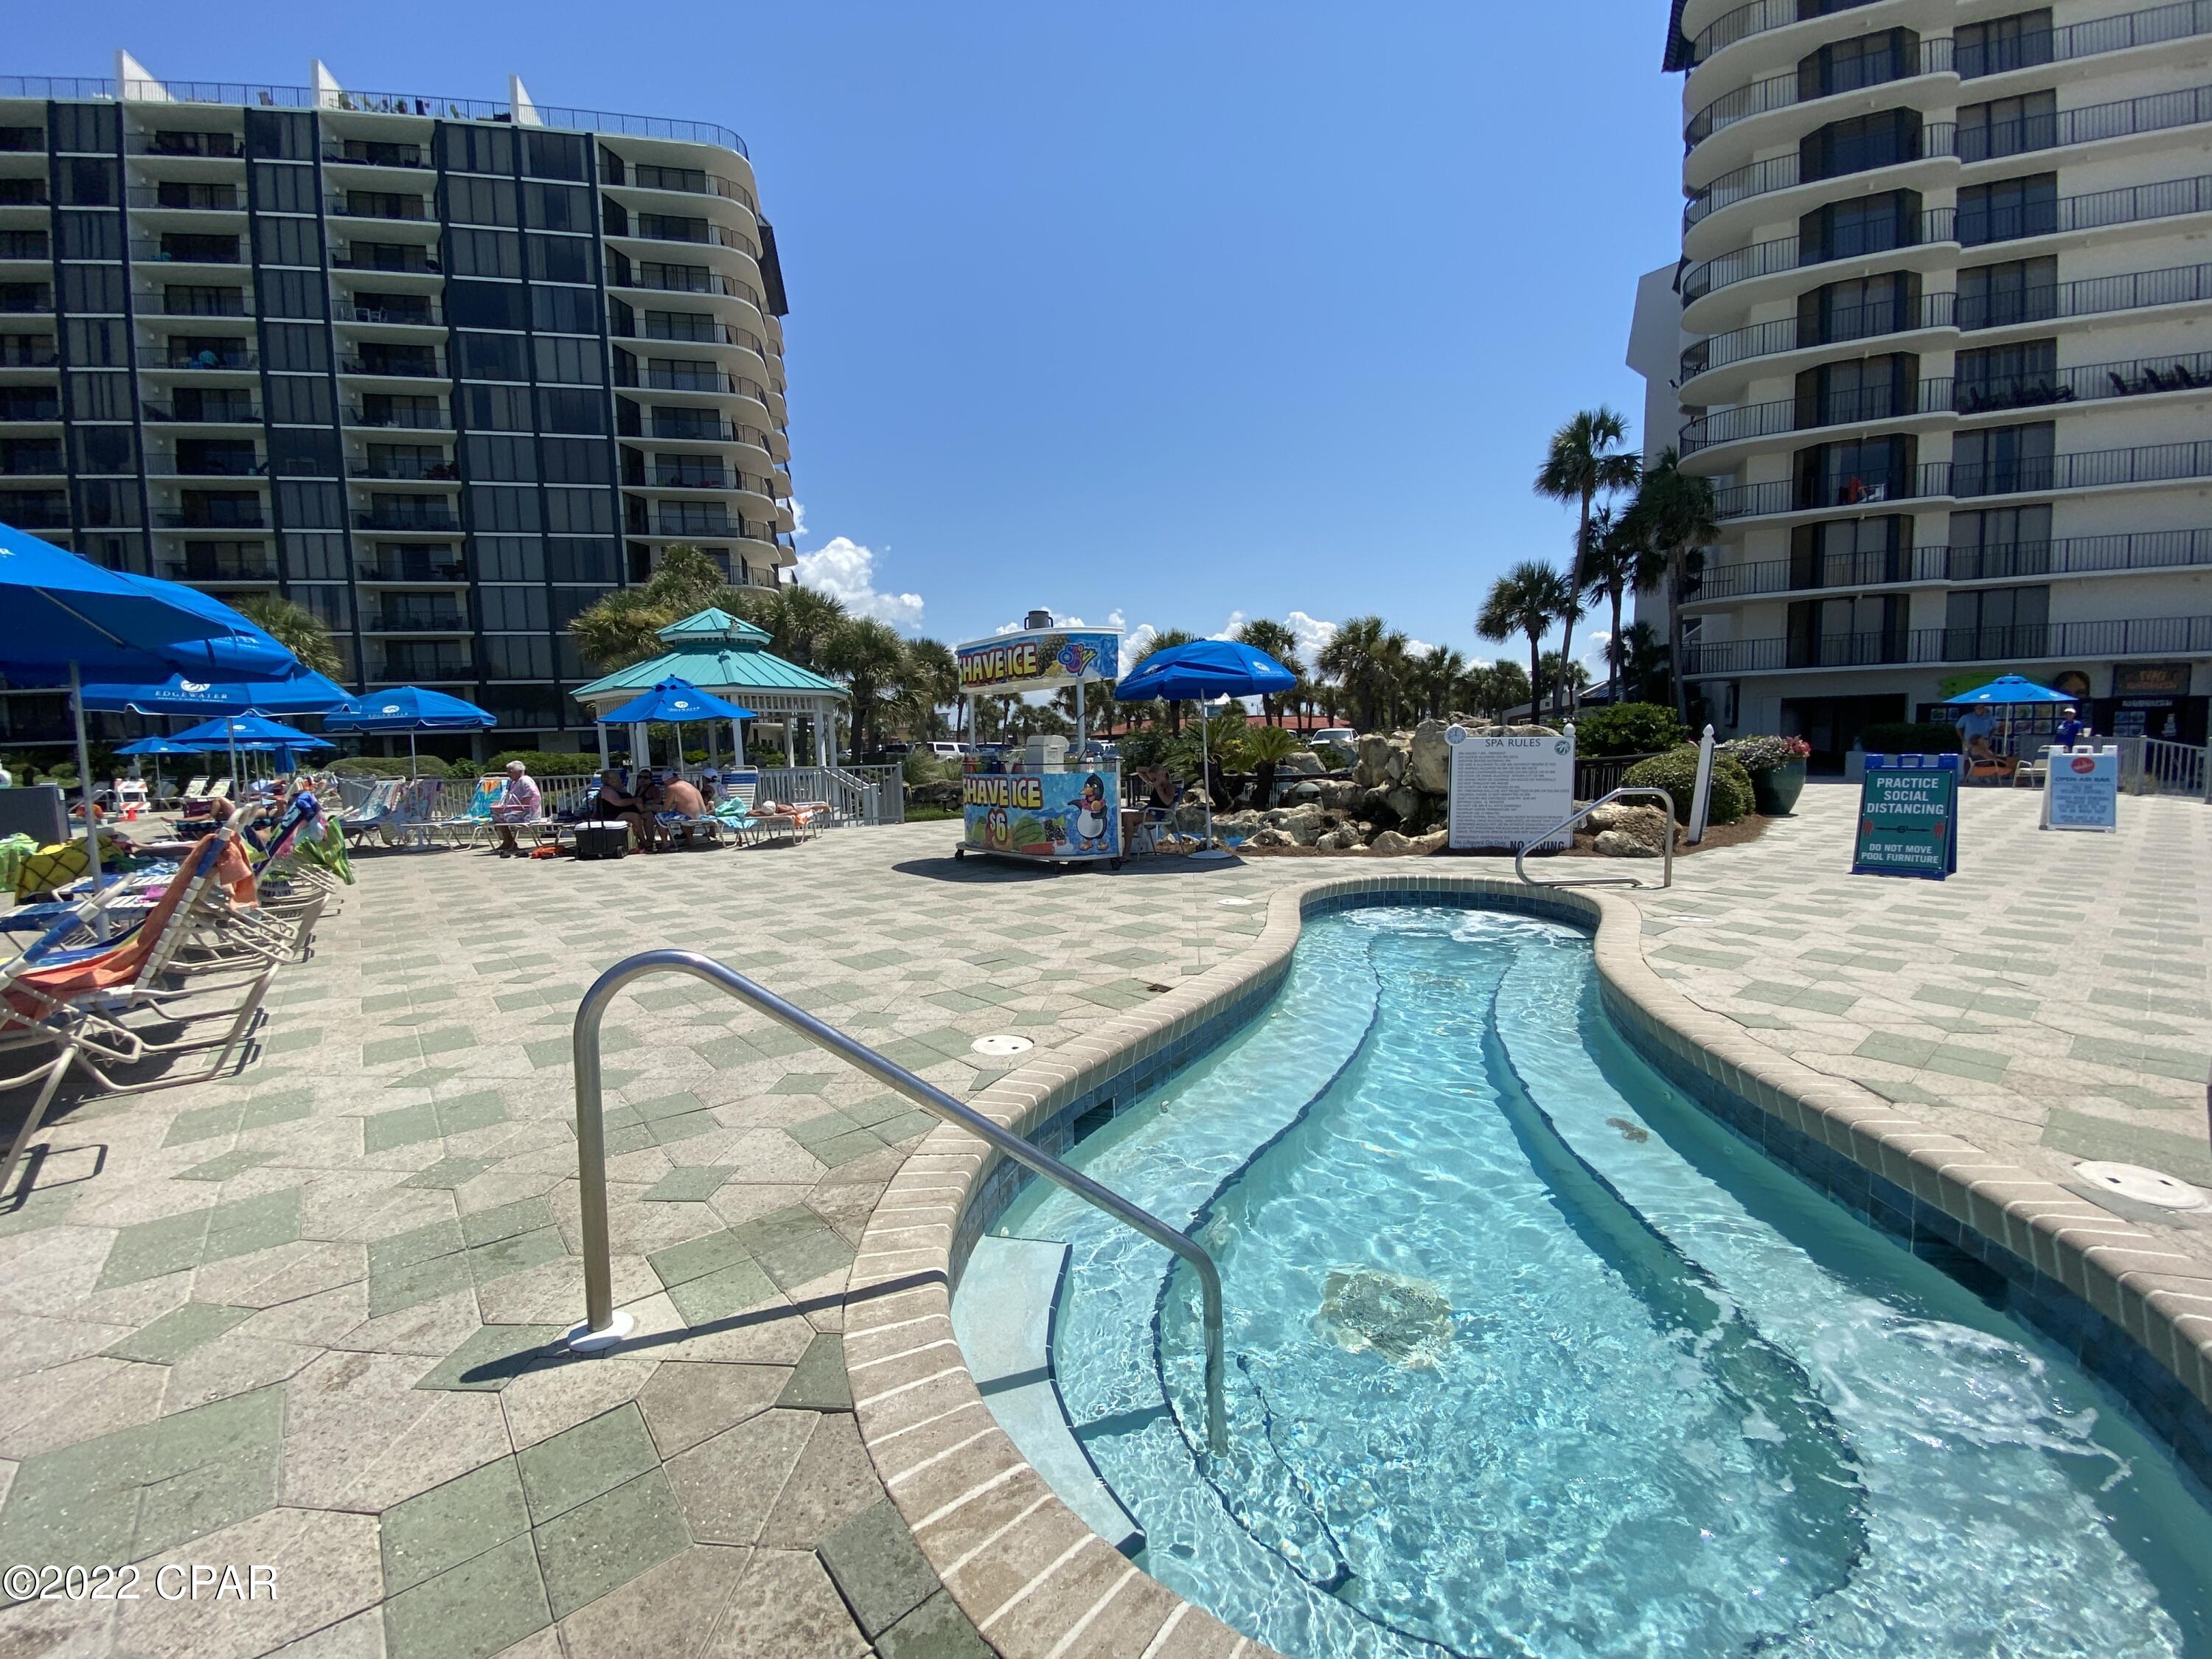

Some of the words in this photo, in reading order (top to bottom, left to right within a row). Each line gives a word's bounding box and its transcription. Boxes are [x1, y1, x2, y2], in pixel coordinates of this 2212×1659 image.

[1007, 644, 1037, 676] ICE
[155, 690, 228, 699] EDGEWATER
[1485, 739, 1504, 747] SPA
[1508, 738, 1540, 747] RULES
[1877, 778, 1939, 788] PRACTICE
[1012, 779, 1042, 808] ICE
[1883, 790, 1930, 801] SOCIAL
[1866, 803, 1944, 815] DISTANCING
[988, 812, 1007, 842] $6
[1510, 840, 1524, 850] NO
[1528, 841, 1565, 850] VING
[1869, 844, 1882, 852] DO
[1884, 844, 1903, 852] NOT
[1905, 845, 1933, 854] MOVE
[1861, 852, 1884, 860] POOL
[1886, 853, 1939, 863] FURNITURE
